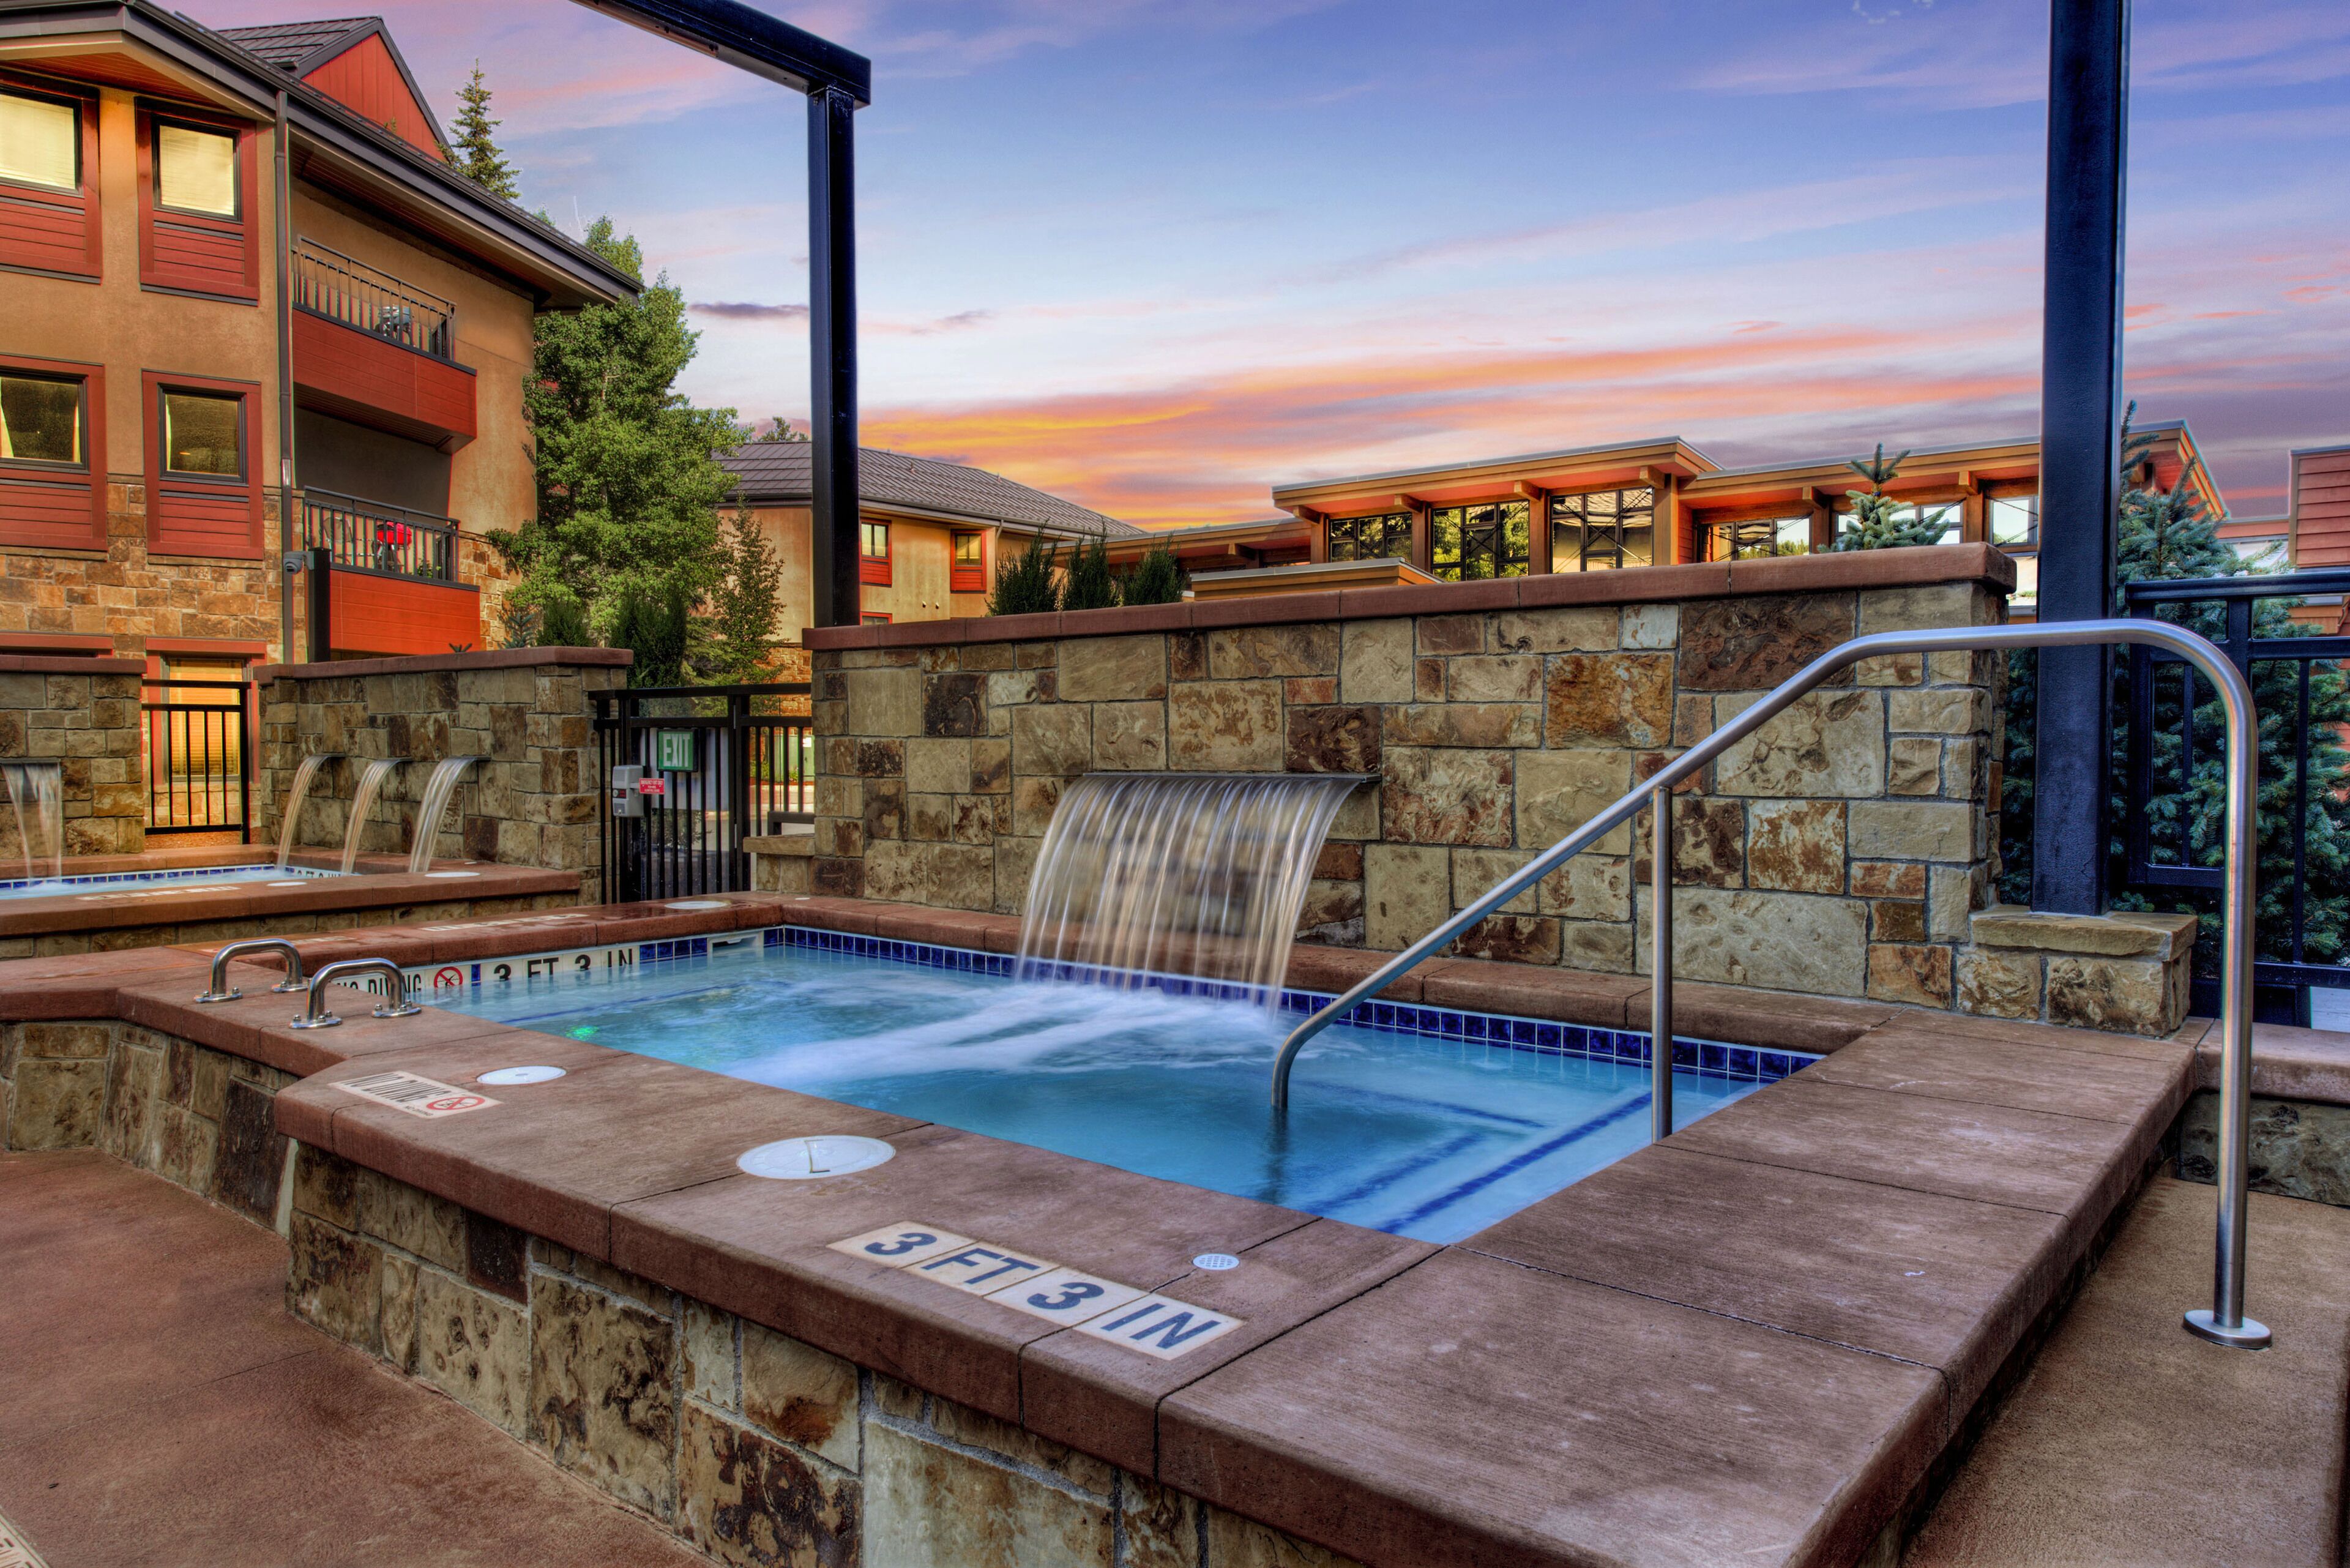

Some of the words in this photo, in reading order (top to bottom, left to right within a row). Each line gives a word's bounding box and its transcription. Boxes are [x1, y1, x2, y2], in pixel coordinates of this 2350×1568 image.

[663, 734, 690, 767] EXIT
[494, 964, 512, 981] 3
[528, 957, 559, 978] FT
[575, 954, 591, 970] 3
[608, 949, 633, 968] IN
[368, 974, 422, 996] DIVNG
[340, 1073, 405, 1087] NO
[361, 1080, 452, 1102] DIVING
[864, 1233, 938, 1255] 3
[921, 1247, 1041, 1285] FT
[1027, 1282, 1105, 1309] 3
[1100, 1303, 1222, 1350] IN
